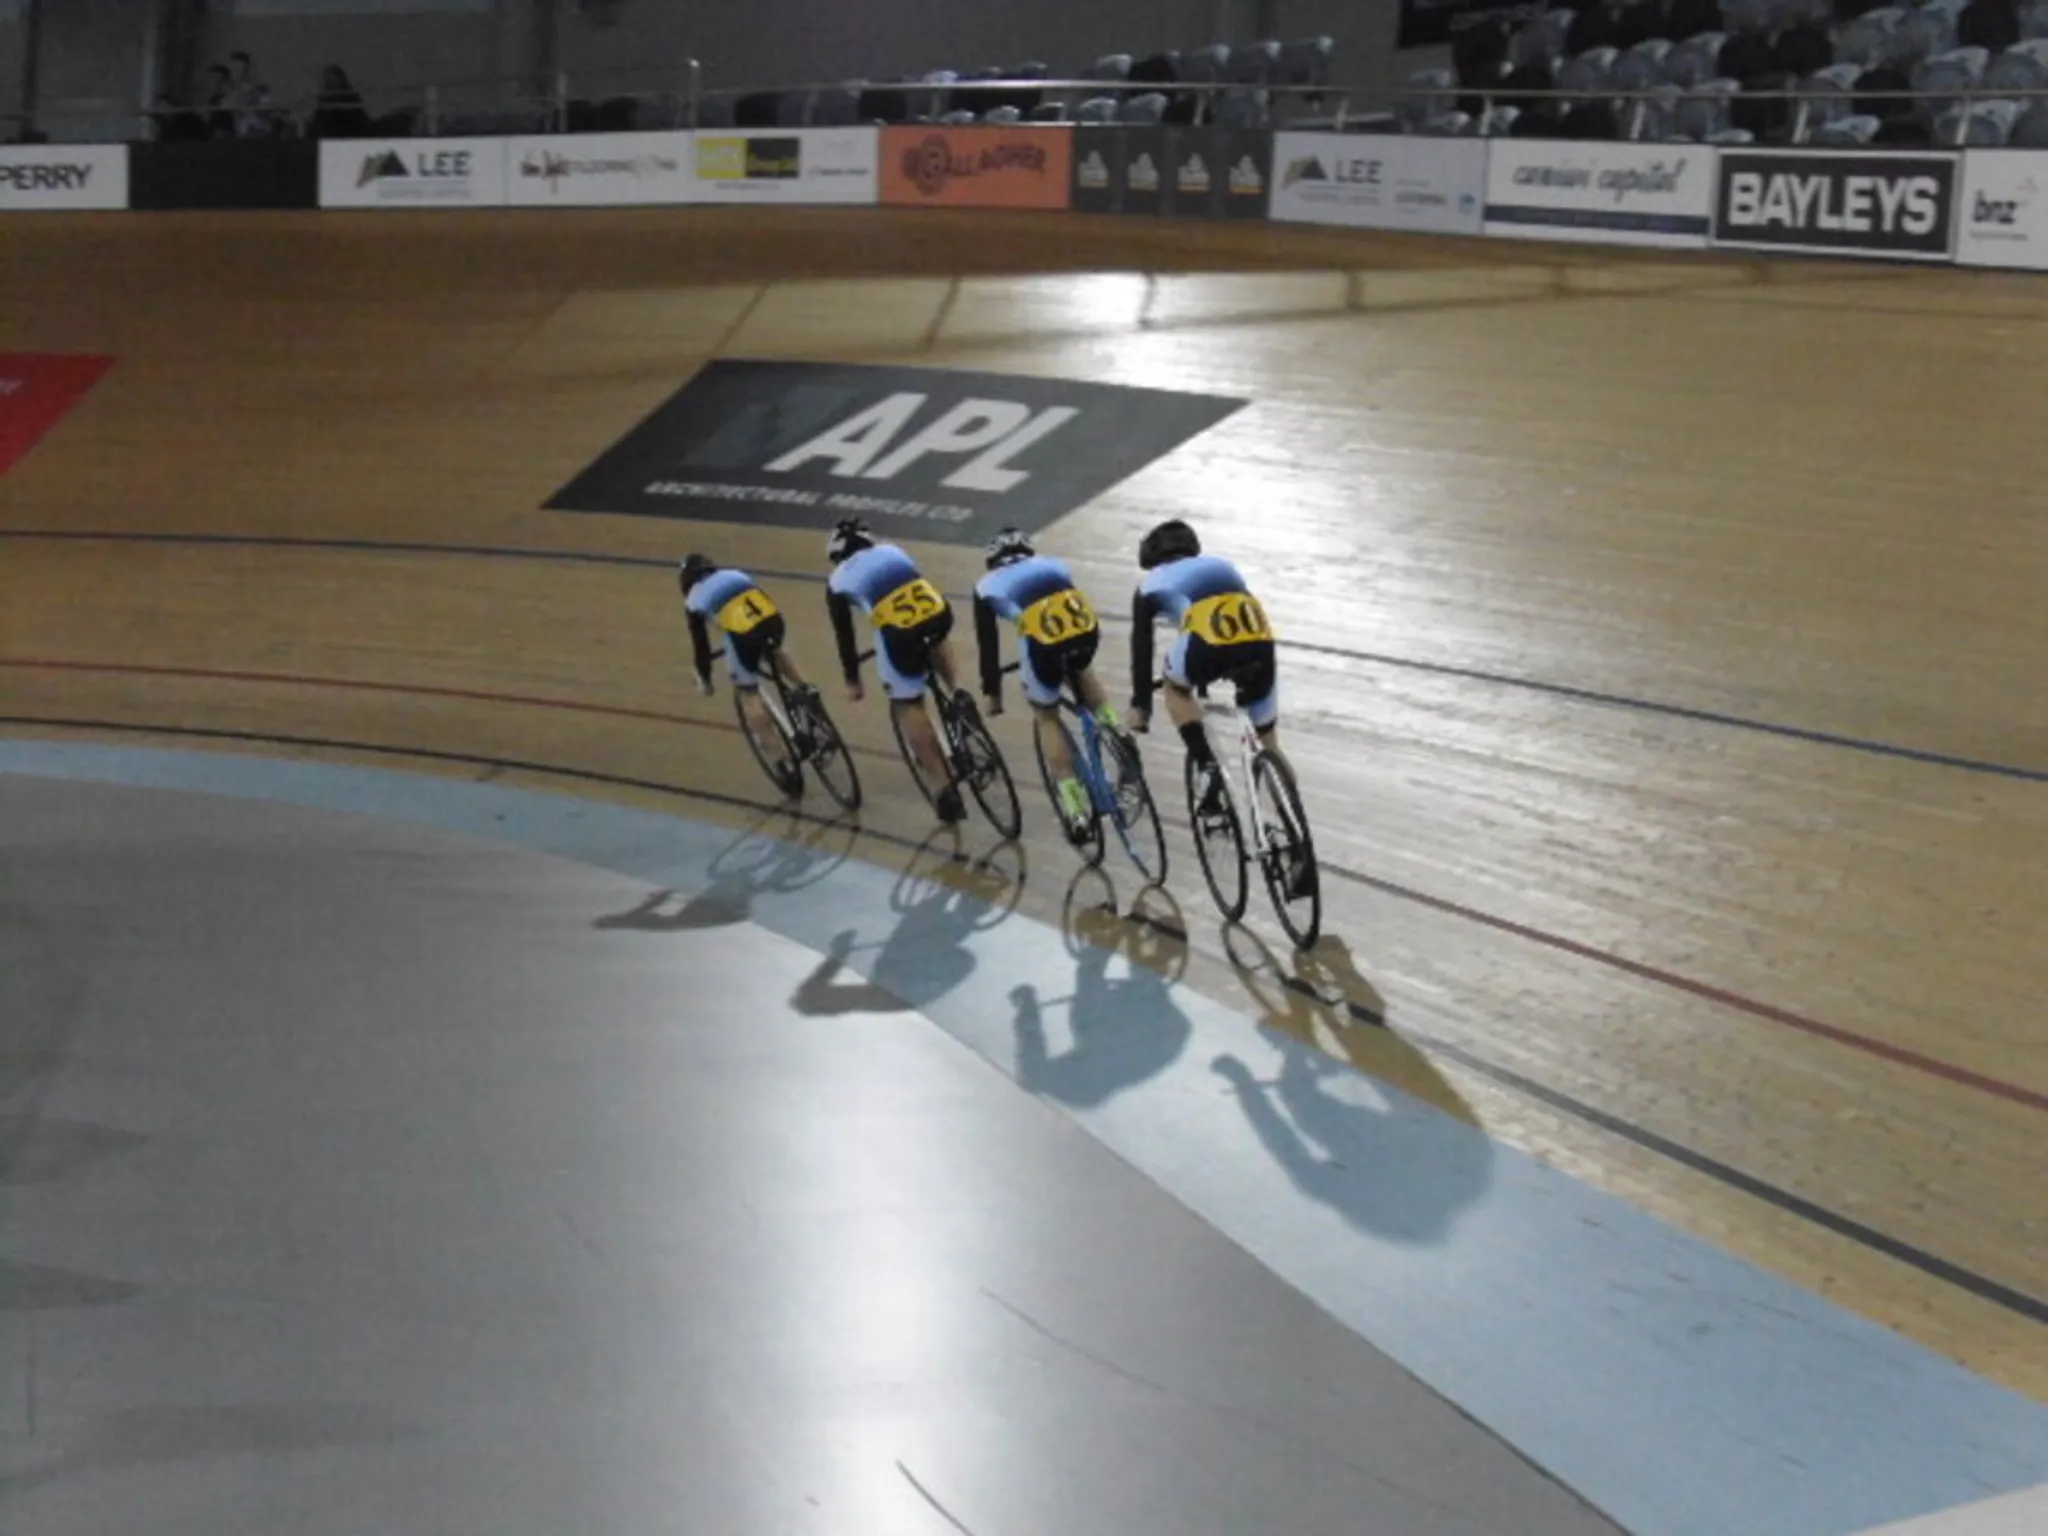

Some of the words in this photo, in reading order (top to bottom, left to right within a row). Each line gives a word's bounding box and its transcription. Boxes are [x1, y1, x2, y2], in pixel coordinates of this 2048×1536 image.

[417, 150, 472, 177] LEE
[1335, 158, 1383, 184] LEE
[1727, 171, 1941, 235] BAYLEYS
[763, 391, 1080, 492] APL
[644, 480, 820, 506] ARCHITECTURAL
[743, 597, 763, 620] 4
[892, 586, 936, 625] 55
[1040, 595, 1090, 638] 68
[1210, 600, 1271, 641] 60
